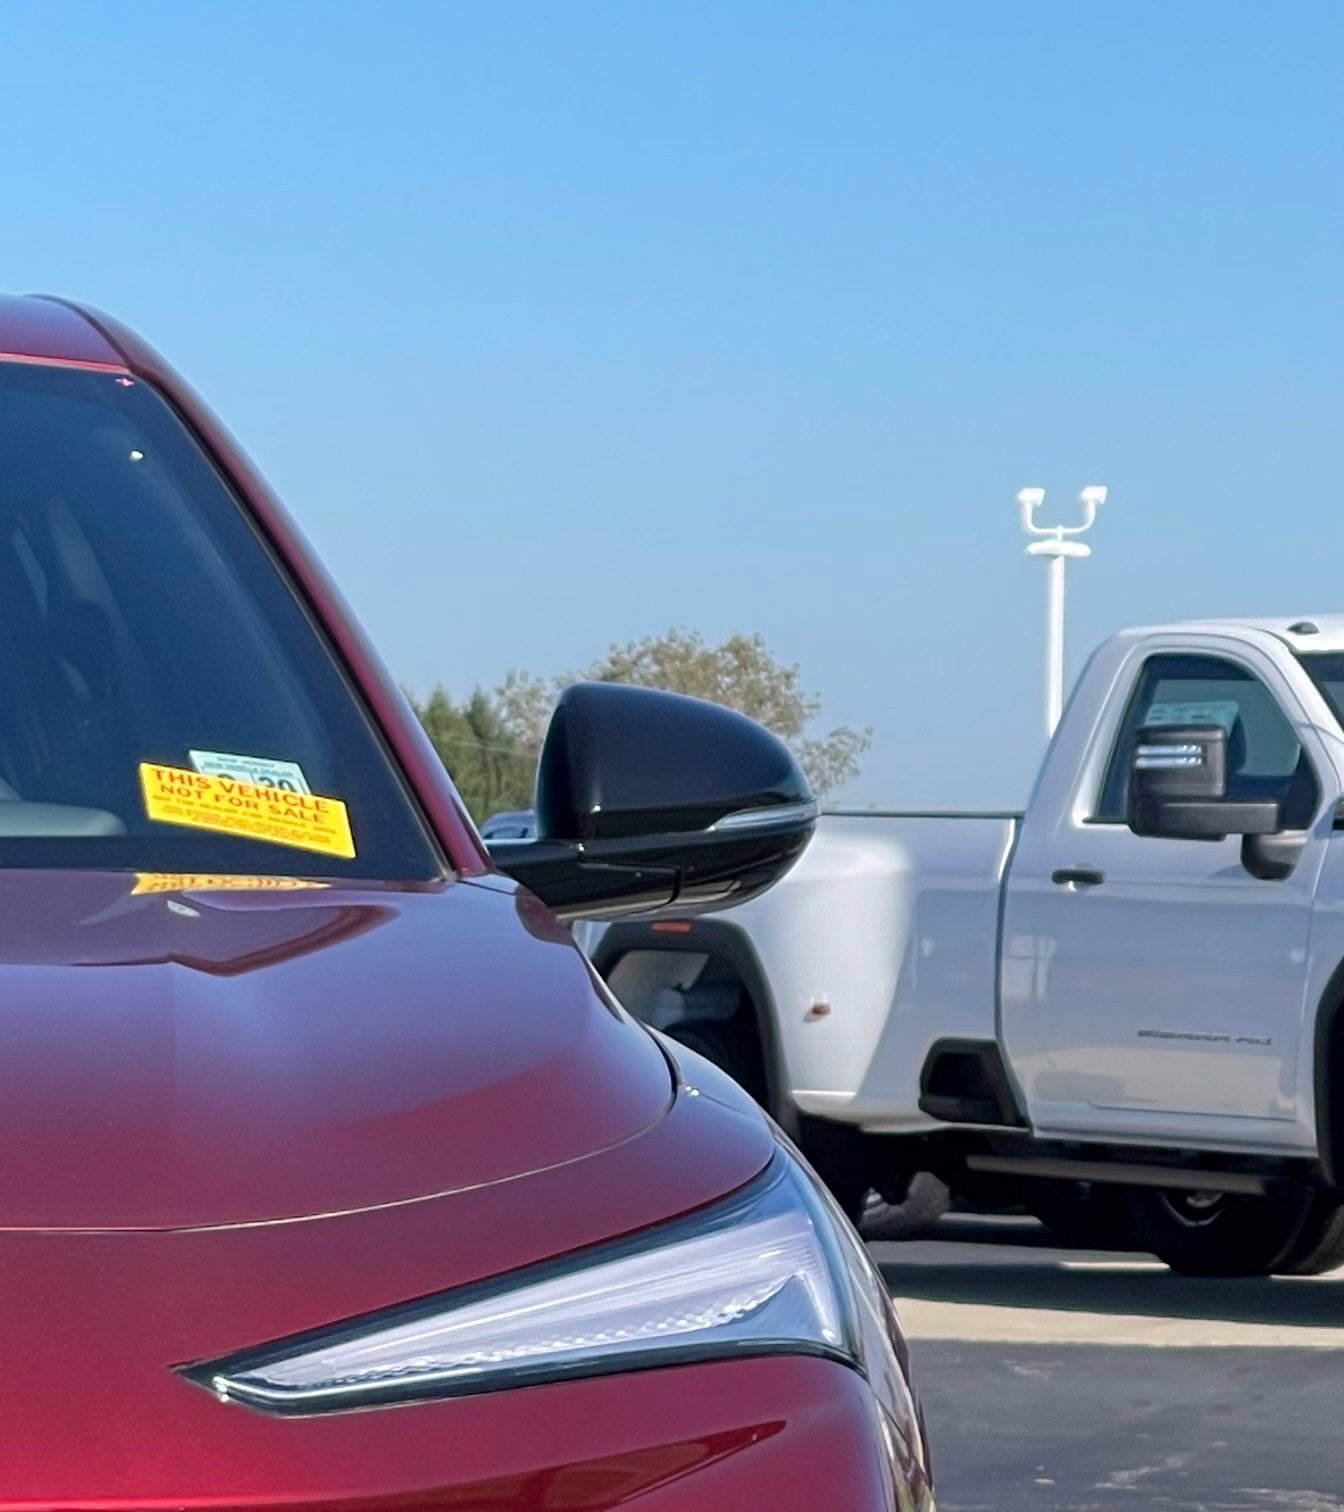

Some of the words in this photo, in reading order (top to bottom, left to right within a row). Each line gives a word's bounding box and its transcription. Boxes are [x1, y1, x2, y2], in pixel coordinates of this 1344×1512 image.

[153, 768, 212, 790] THIS
[218, 781, 329, 814] VEHICLE
[160, 784, 206, 800] NOT
[213, 794, 259, 811] FOR
[268, 804, 327, 823] SALE
